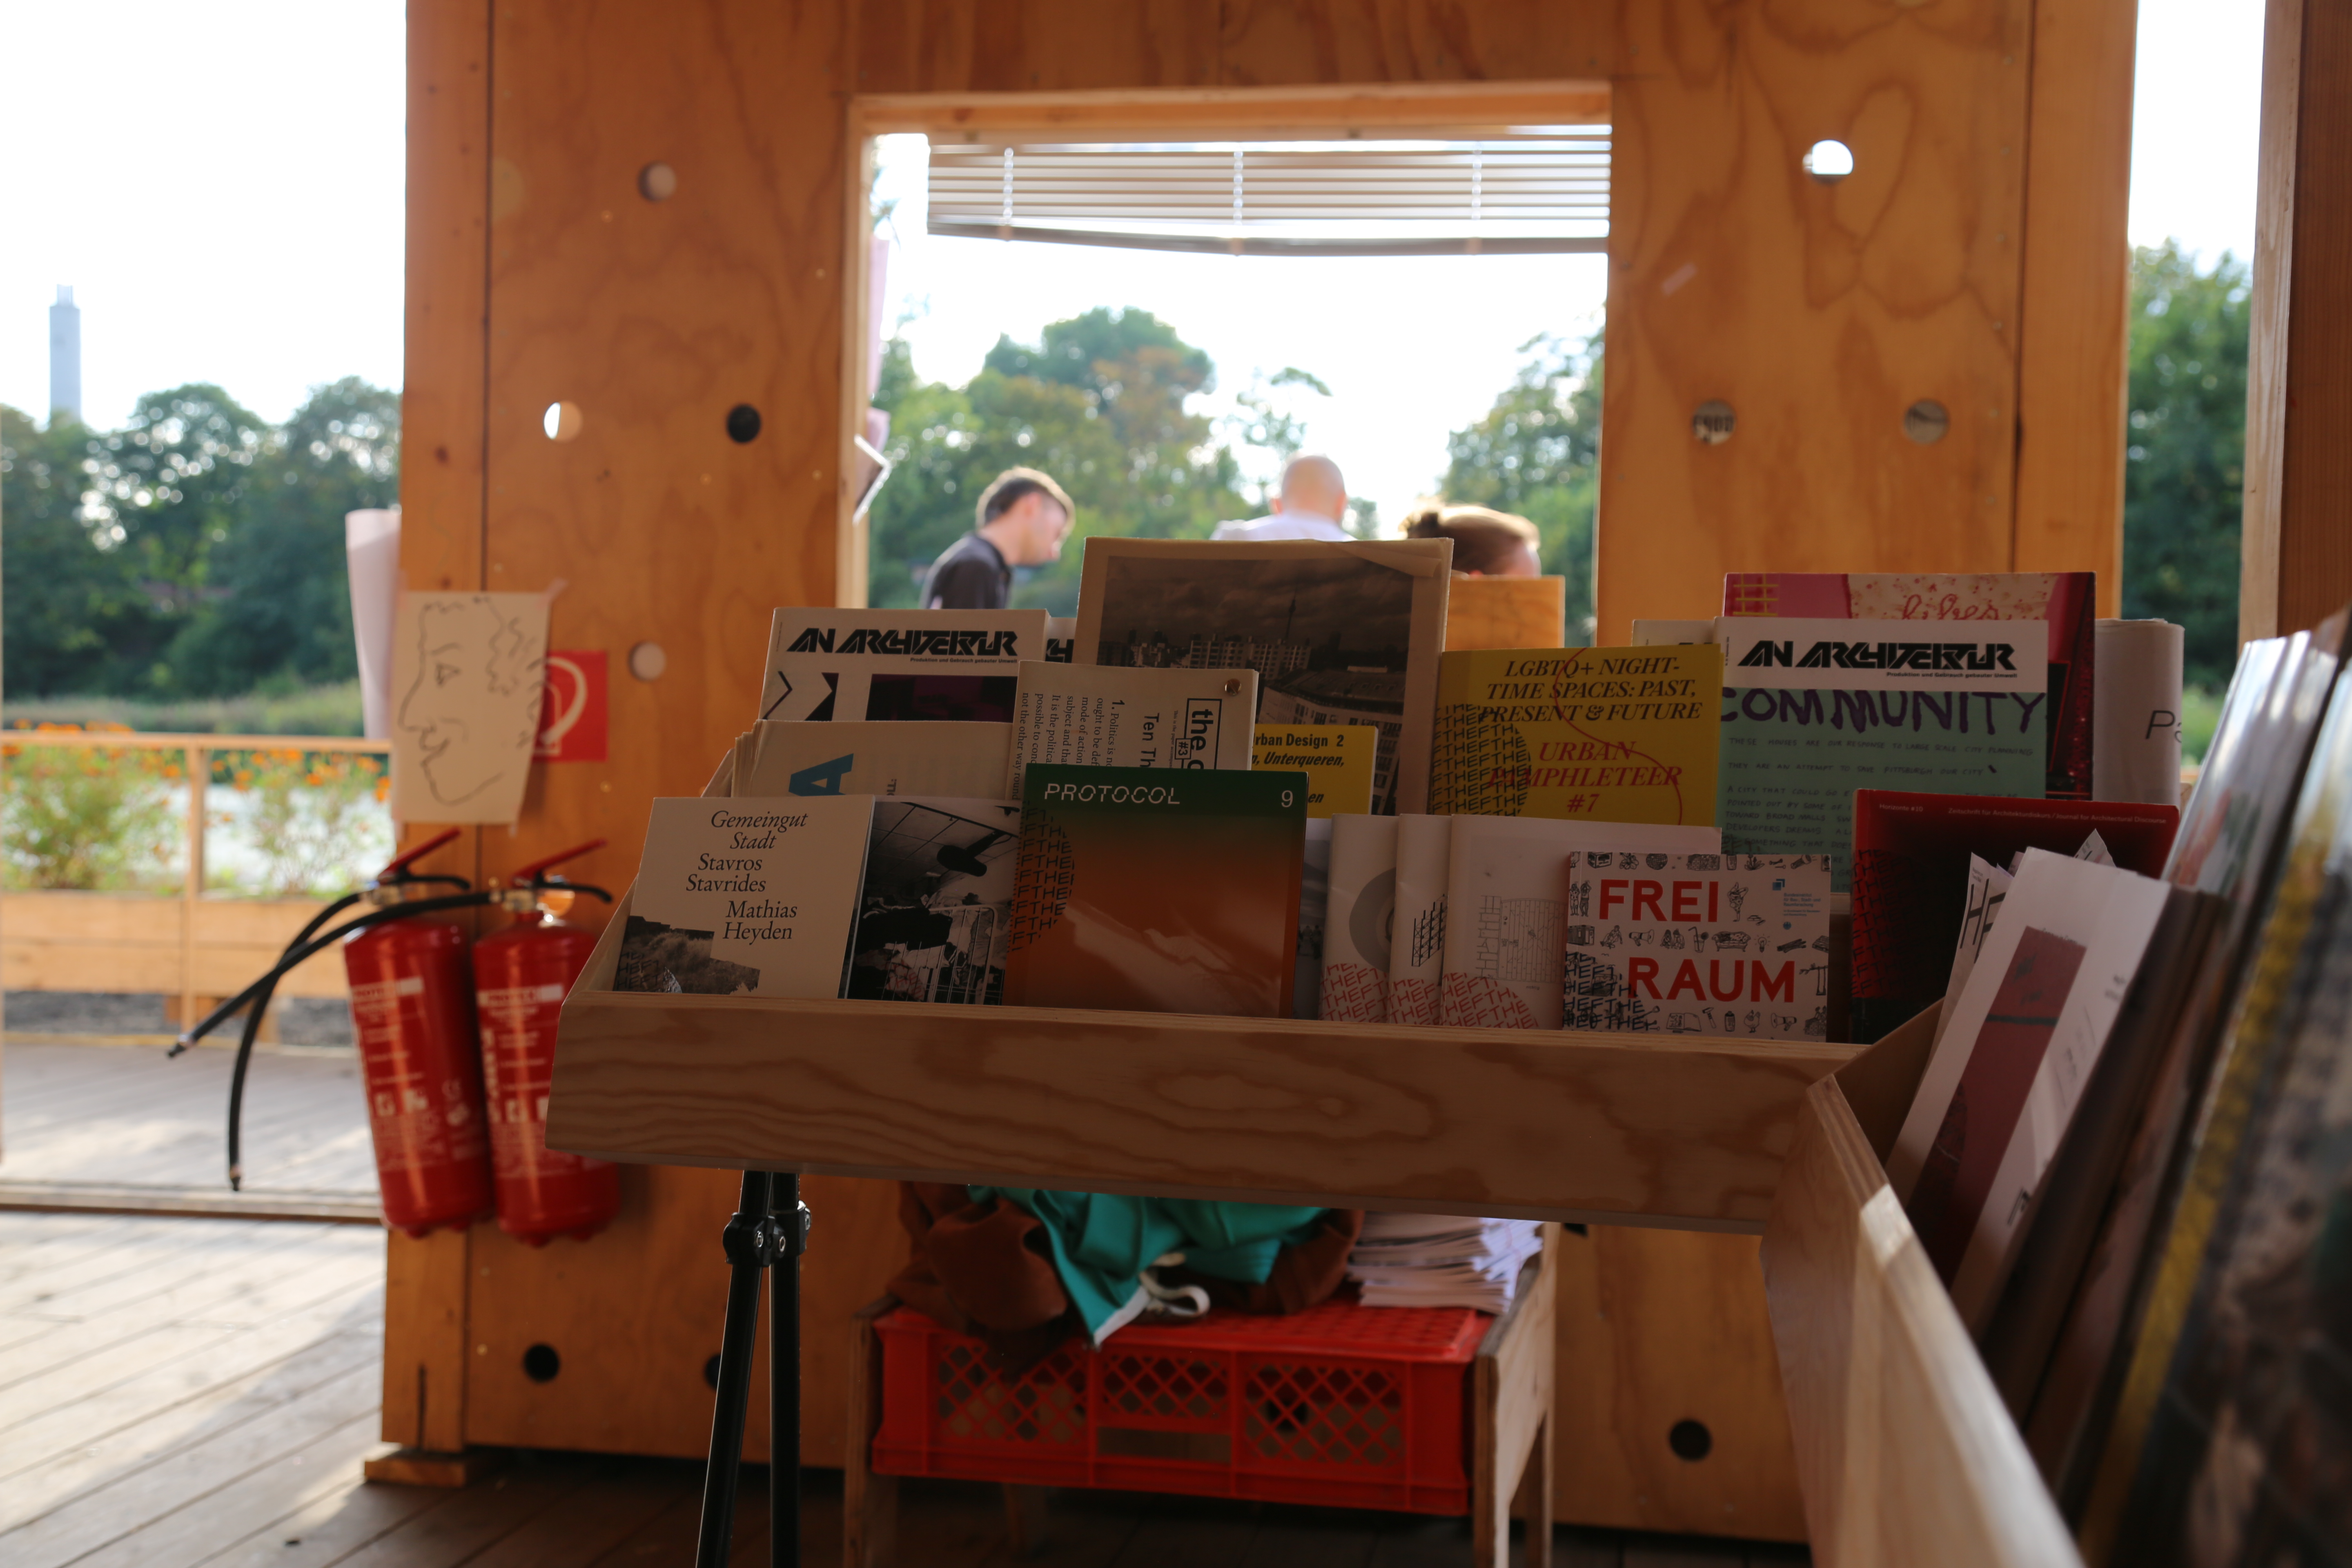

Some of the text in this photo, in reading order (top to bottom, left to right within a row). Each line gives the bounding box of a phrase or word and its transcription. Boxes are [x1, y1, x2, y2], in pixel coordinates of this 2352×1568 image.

[786, 628, 836, 653] AN
[835, 629, 1018, 656] ARCHITEKTUR
[1738, 640, 1793, 667] AN
[1796, 641, 2017, 670] ARCHITEKTUR
[1505, 657, 1680, 678] LGBTQ+ NIGHT-
[1488, 679, 1696, 699] TIME SPACES: PAST,
[1052, 695, 1060, 704] It
[1111, 699, 1125, 710] 1.
[1021, 709, 1029, 724] the
[1033, 693, 1044, 729] possible
[1050, 715, 1058, 727] the
[1064, 696, 1074, 727] subject
[1093, 698, 1104, 724] ought
[1480, 705, 1582, 722] PRESENT
[1586, 706, 1604, 721] &
[1606, 702, 1703, 721] FUTURE
[1033, 731, 1039, 740] to
[1064, 729, 1072, 742] and
[1080, 725, 1088, 735] of
[1108, 713, 1119, 747] Politics
[1143, 713, 1160, 741] Ten
[1190, 709, 1214, 751] the
[1018, 726, 1027, 750] other
[1094, 737, 1102, 748] be
[1178, 741, 1188, 755] #3
[1254, 733, 1344, 749] rban Design 2
[1728, 737, 1757, 746] THESE
[1847, 740, 1885, 748] RESPONSE
[1935, 744, 1956, 752] SCALE
[1988, 747, 2034, 756] PLANNING
[1076, 738, 1086, 764] action
[1264, 752, 1344, 768] Unterqueren,
[1539, 741, 1636, 761] URBAN
[1012, 753, 1022, 773] way
[1884, 765, 1933, 775] PITTSBURGH
[1012, 773, 1020, 800] round
[1488, 767, 1683, 788] PAMPHLETEER
[1044, 784, 1293, 808] PROTOCOL 9
[1567, 794, 1600, 813] #7
[1880, 803, 1909, 811] Horizonte
[1992, 809, 2050, 818] Architekturdiskurs
[711, 810, 808, 833] Gemeingut
[1726, 822, 1780, 833] DEVELOPERS
[1786, 826, 1821, 835] DREAMS
[730, 832, 776, 849] Stadt
[698, 853, 762, 871] Stavros
[686, 874, 766, 892] Stavrides
[725, 900, 797, 918] Mathias
[1599, 879, 1719, 922] FREI
[722, 922, 793, 944] Heyden
[1628, 956, 1795, 1002] RAUM
